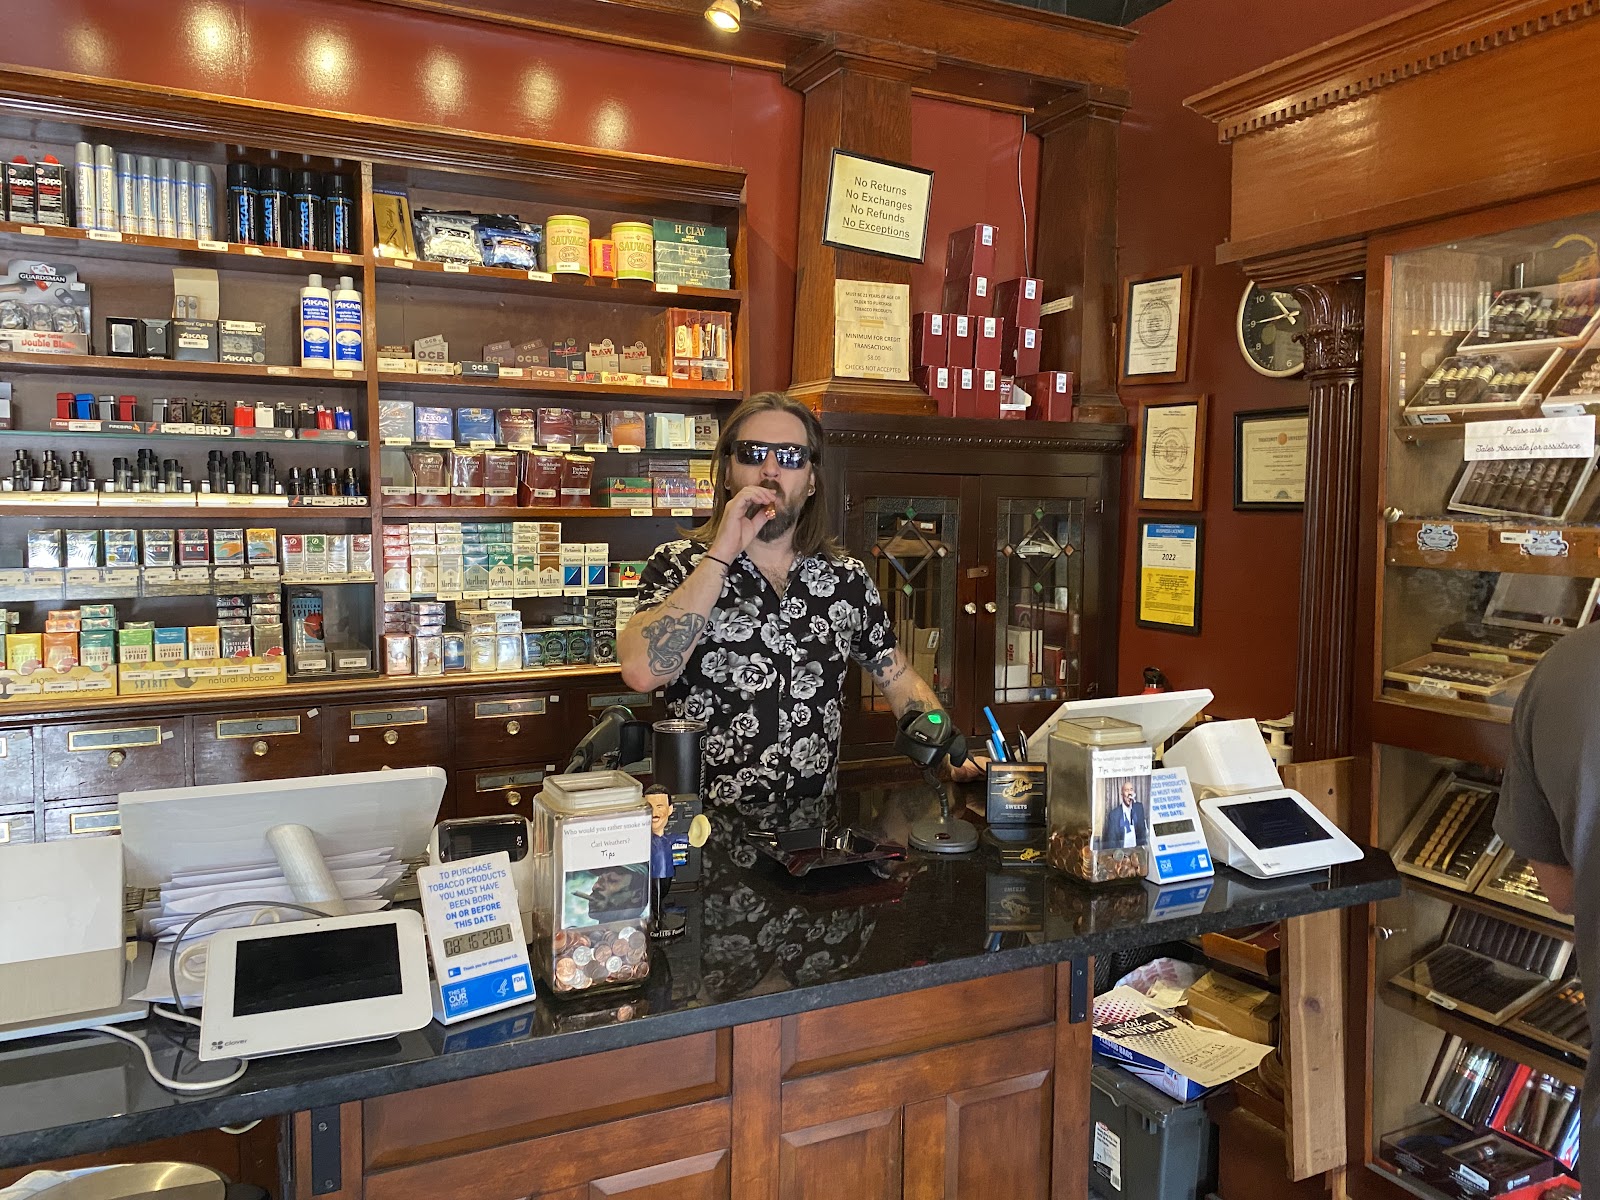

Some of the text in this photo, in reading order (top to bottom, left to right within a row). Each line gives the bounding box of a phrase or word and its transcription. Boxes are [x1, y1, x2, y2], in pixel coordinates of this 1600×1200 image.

[854, 176, 907, 196] No Returns
[845, 188, 913, 211] No Exchanges
[850, 203, 905, 223] No Refunds
[674, 224, 706, 237] H. CLAY
[842, 216, 910, 238] No Exceptions
[20, 273, 66, 282] GUARDSMAN
[1256, 295, 1265, 304] 10
[1250, 320, 1256, 328] 9
[21, 339, 51, 348] Double
[424, 337, 437, 345] OCB
[854, 342, 894, 351] TRANSACTIONS:
[418, 351, 445, 360] OCB
[591, 348, 614, 357] RAW
[624, 351, 646, 360] RAW
[516, 355, 540, 363] OCB
[1268, 356, 1274, 364] 7
[876, 366, 902, 374] ACCEPTED
[576, 373, 595, 382] RAW
[1503, 425, 1529, 436] Please
[1529, 426, 1542, 434] ask
[1495, 443, 1530, 452] Associate
[1529, 442, 1542, 455] for
[1543, 442, 1581, 450] assistance
[1161, 553, 1177, 561] 2022
[466, 575, 488, 586] Marlboro
[491, 576, 513, 587] Marlboro
[516, 574, 536, 585] Marlboro
[540, 574, 560, 584] Marlboro
[595, 630, 615, 638] CAMEL
[134, 679, 169, 689] SPIRIT
[208, 674, 275, 685] natural tobacco
[386, 713, 393, 721] D
[256, 723, 263, 731] C
[112, 734, 120, 743] B
[1002, 783, 1033, 798] Capone
[578, 826, 595, 834] would
[595, 826, 607, 834] you
[607, 823, 623, 831] rather
[624, 822, 641, 830] smoke
[590, 838, 631, 848] Carl Weathers?
[600, 850, 615, 860] Tips
[439, 862, 493, 880] TO PURCHASE
[427, 869, 507, 893] TOBACCO PRODUCTS
[439, 881, 500, 901] YOU MUST HAVE
[449, 892, 494, 910] BEEN BORN
[445, 901, 501, 921] ON OR BEFORE
[454, 913, 497, 930] THIS DATE:
[448, 992, 467, 1003] OUR
[1107, 1020, 1170, 1036] WESTPORT
[224, 1038, 248, 1046] clover
[1119, 1046, 1133, 1060] BAGS
[1182, 1053, 1204, 1065] SEPT
